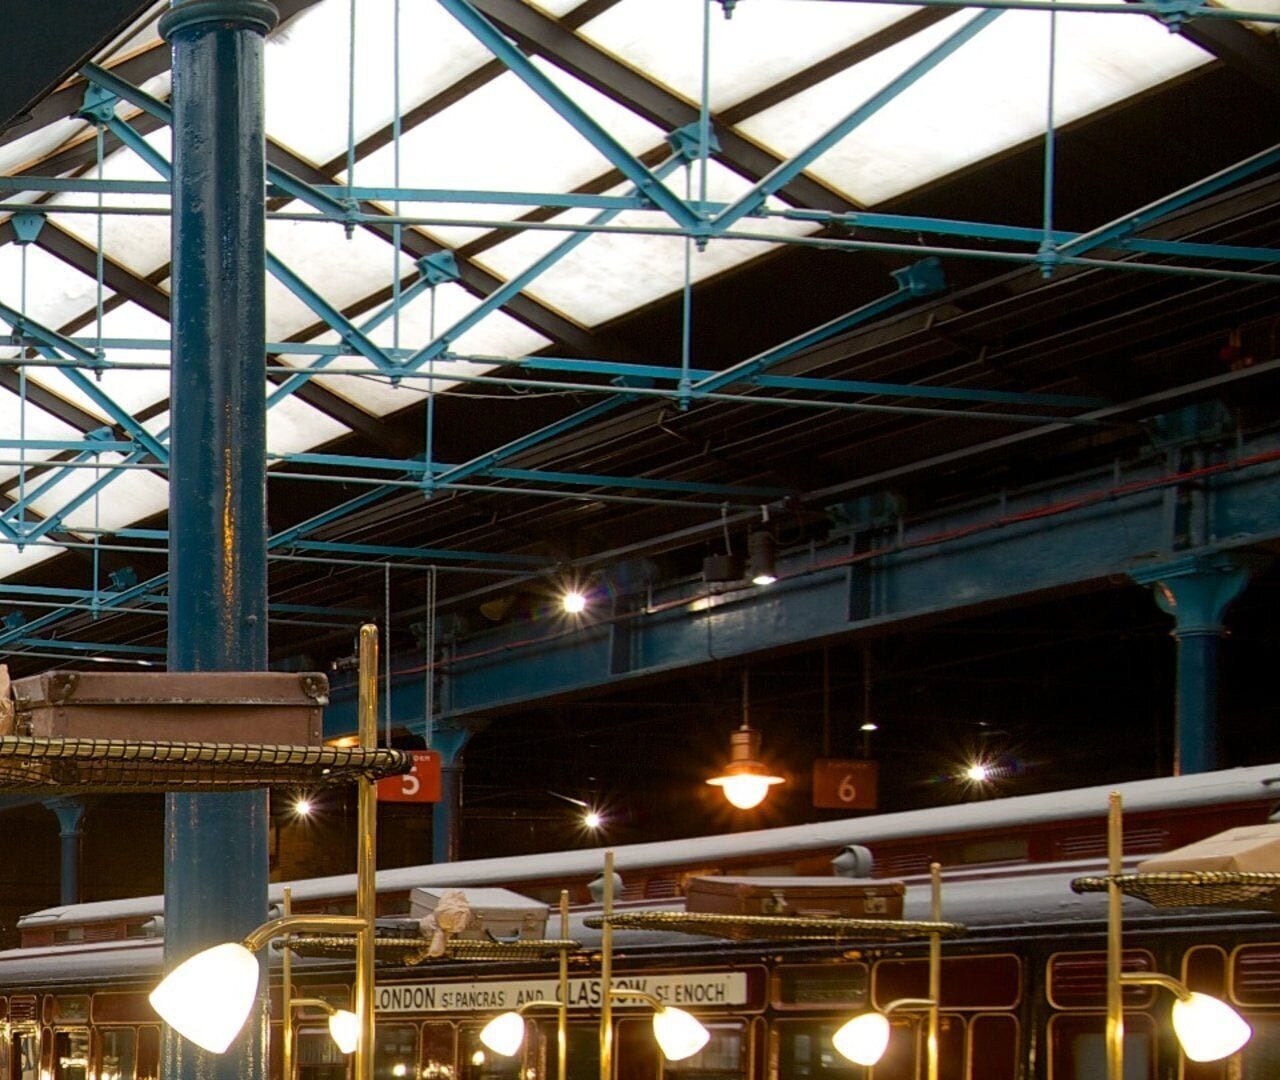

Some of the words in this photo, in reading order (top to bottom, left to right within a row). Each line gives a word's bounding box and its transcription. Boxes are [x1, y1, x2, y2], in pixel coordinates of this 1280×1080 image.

[402, 766, 419, 795] 5
[839, 774, 856, 802] 6
[455, 991, 505, 1007] PANCRAS
[516, 989, 544, 1006] AND
[674, 982, 726, 1002] ENOCH
